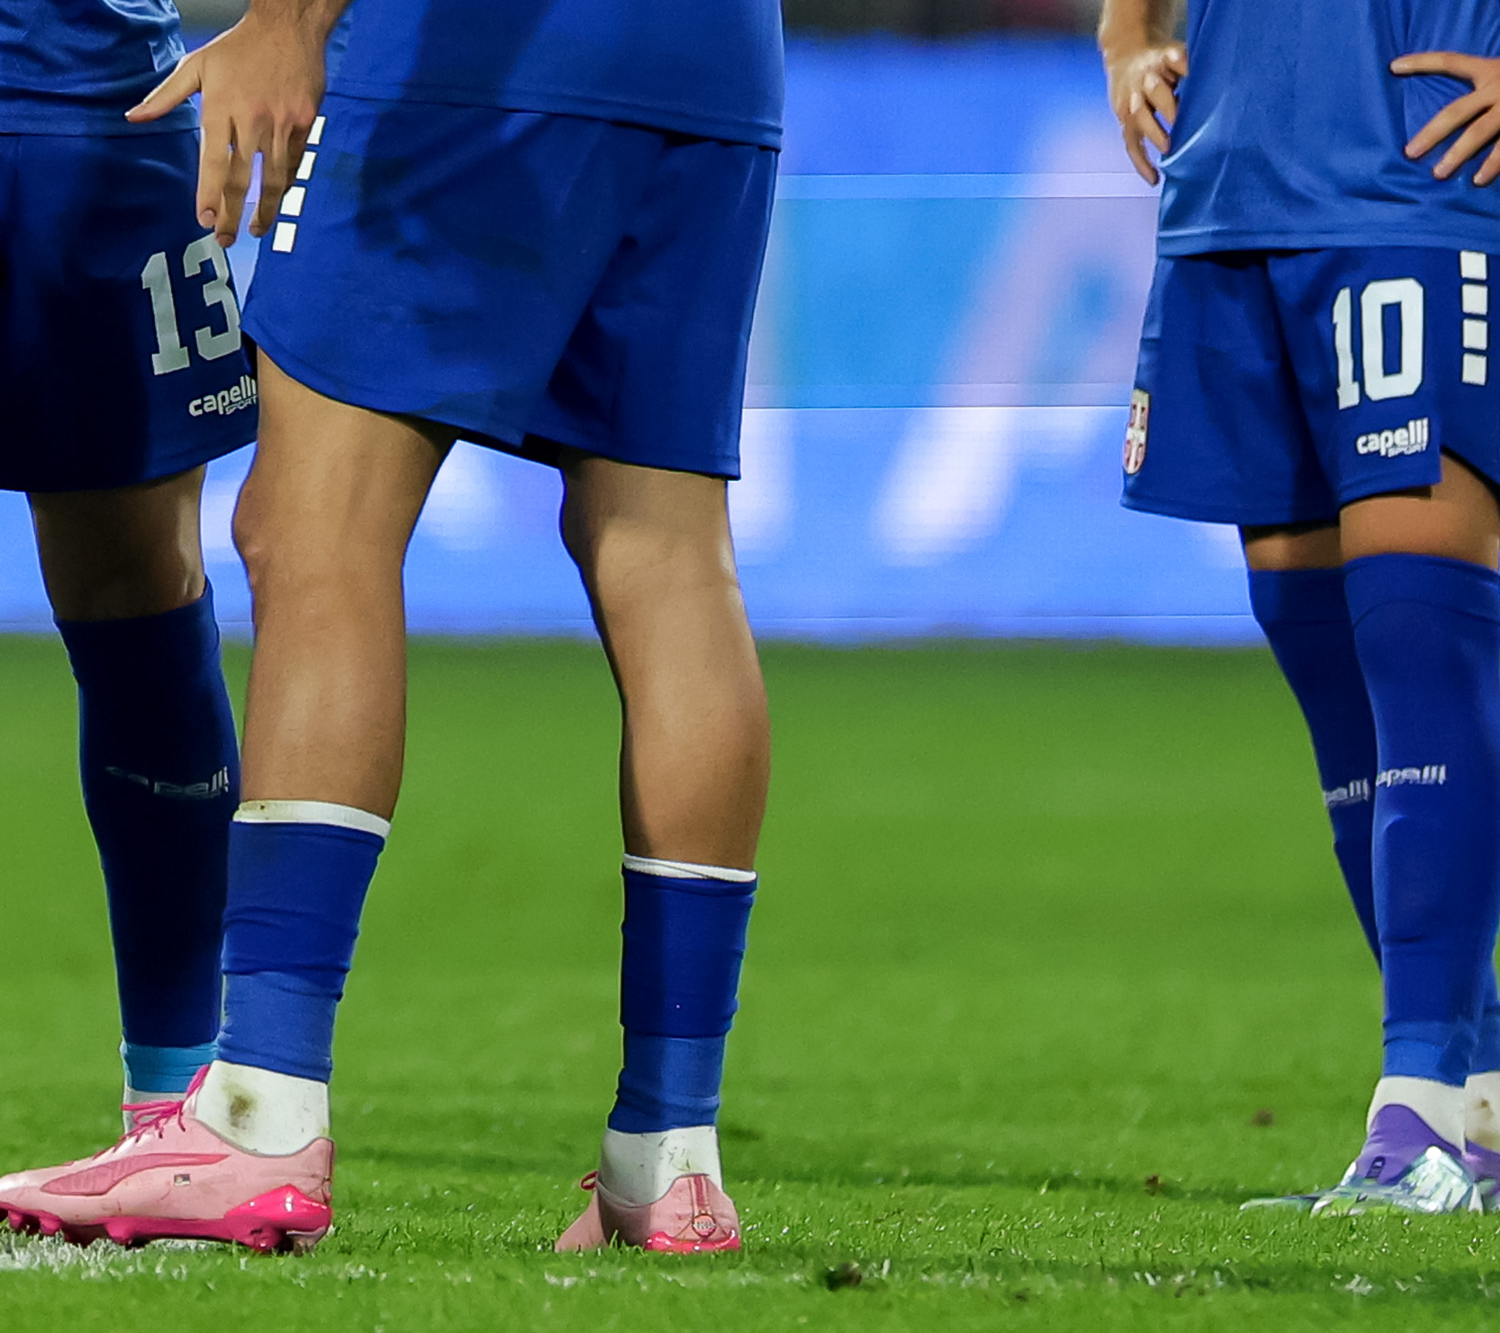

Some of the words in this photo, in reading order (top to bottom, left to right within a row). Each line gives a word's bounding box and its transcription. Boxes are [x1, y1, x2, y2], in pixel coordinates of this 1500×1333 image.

[141, 232, 242, 376] 13
[1333, 276, 1424, 410] 10
[188, 374, 257, 417] capelli
[1356, 417, 1429, 457] capelli
[1376, 763, 1447, 789] apelli
